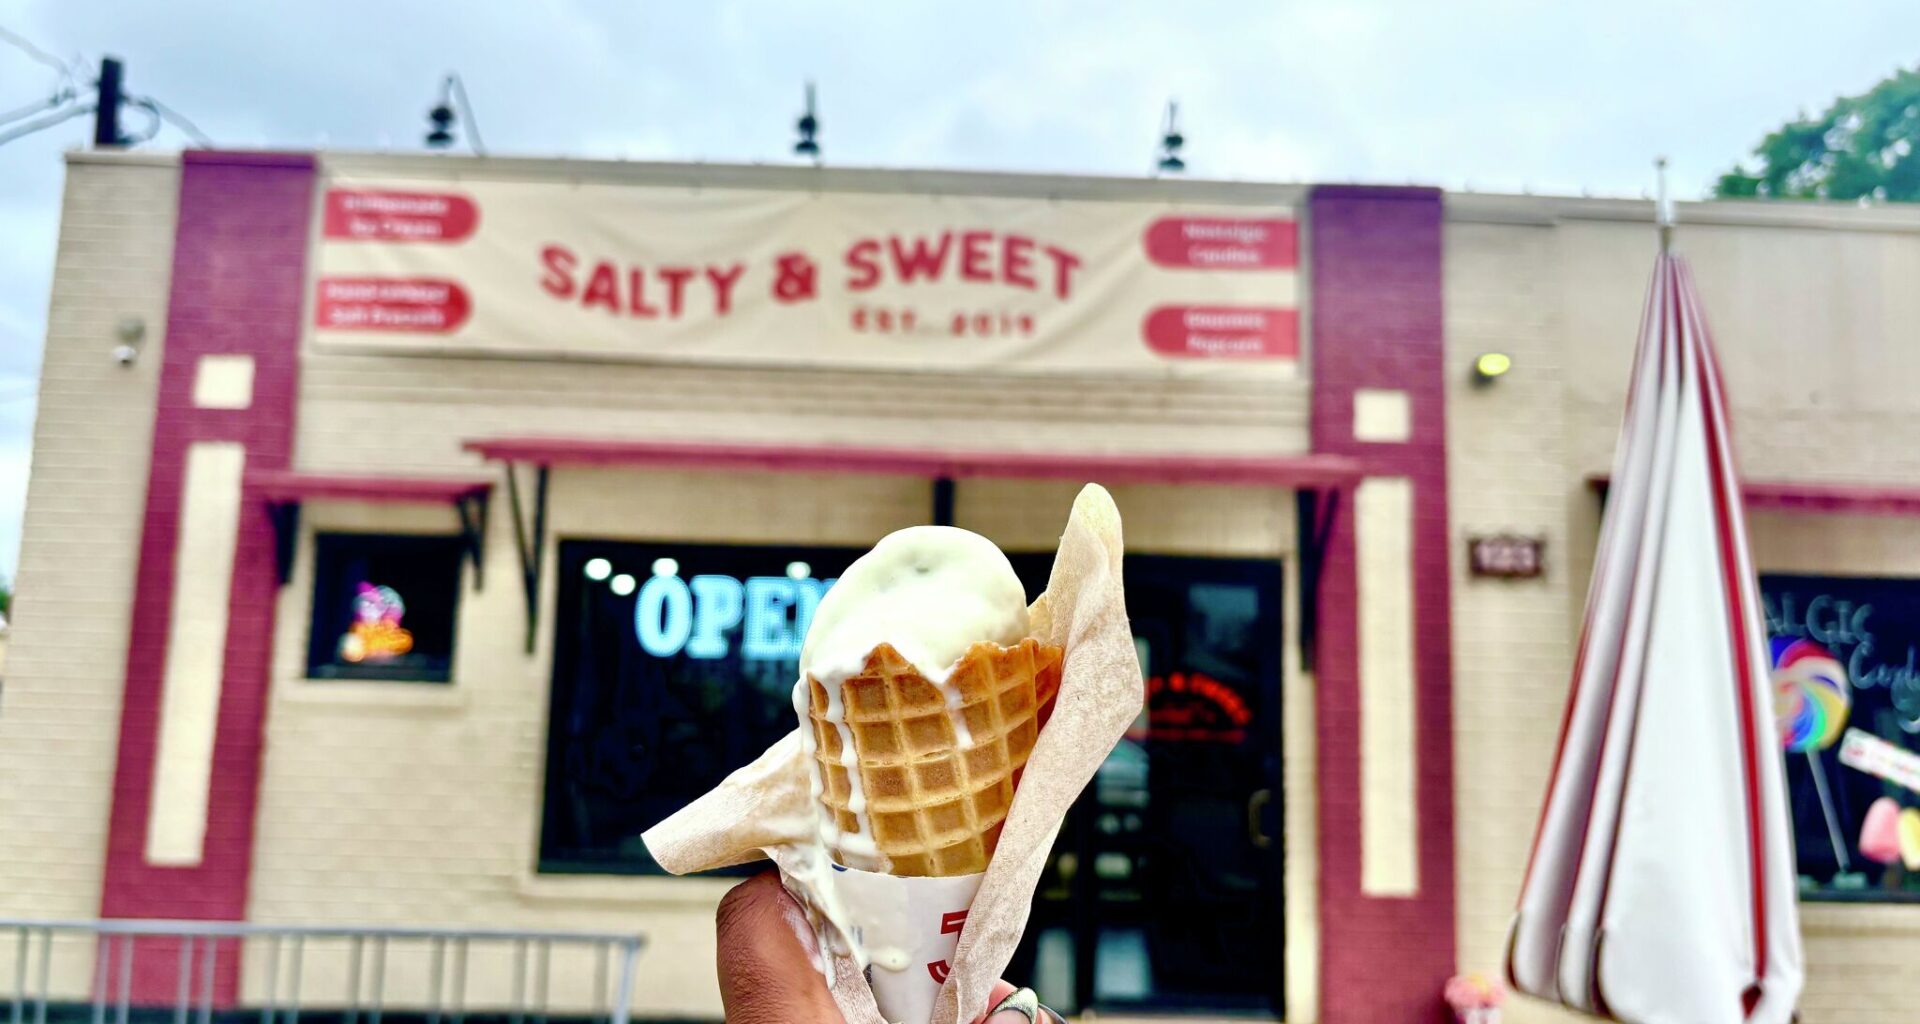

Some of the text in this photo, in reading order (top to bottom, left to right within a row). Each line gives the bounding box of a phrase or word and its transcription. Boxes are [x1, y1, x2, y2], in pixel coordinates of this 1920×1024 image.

[539, 229, 1082, 319] SALTY & SWEET
